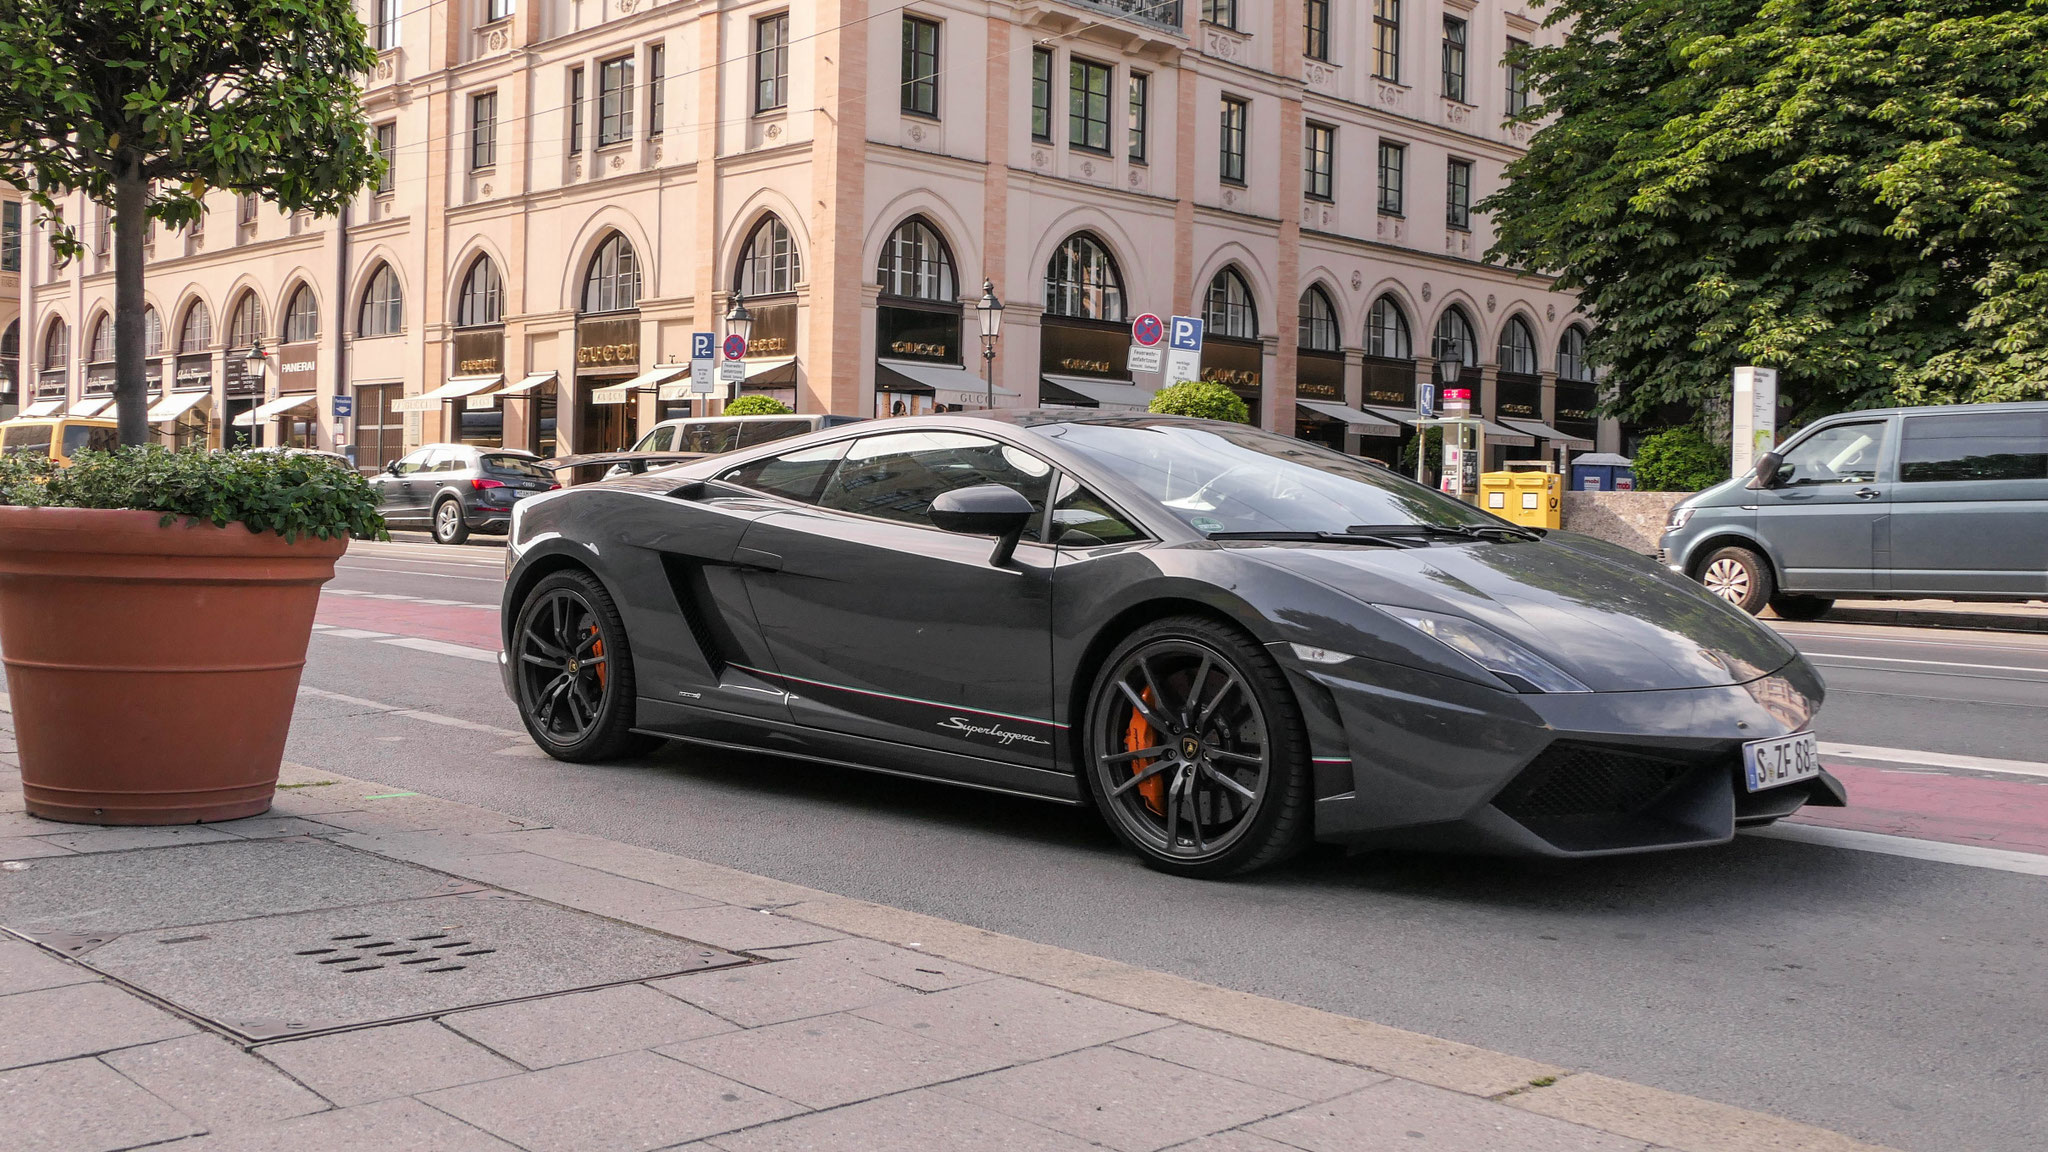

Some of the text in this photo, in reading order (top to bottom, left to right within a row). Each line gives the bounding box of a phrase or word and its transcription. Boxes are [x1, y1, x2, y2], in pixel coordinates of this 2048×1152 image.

[1174, 320, 1194, 345] P
[577, 343, 638, 363] GUCCI
[694, 335, 708, 356] P
[748, 337, 787, 351] UCCI
[891, 341, 945, 357] GUCCI
[281, 360, 315, 373] PANERAI
[1061, 358, 1110, 373] GUCCI
[1201, 366, 1260, 386] GUCCI
[1584, 477, 1600, 485] mobi
[1616, 481, 1632, 490] mobi
[936, 717, 1051, 745] Superleggera
[1756, 747, 1766, 783] S
[1774, 742, 1791, 779] ZF
[1795, 739, 1811, 774] 88
